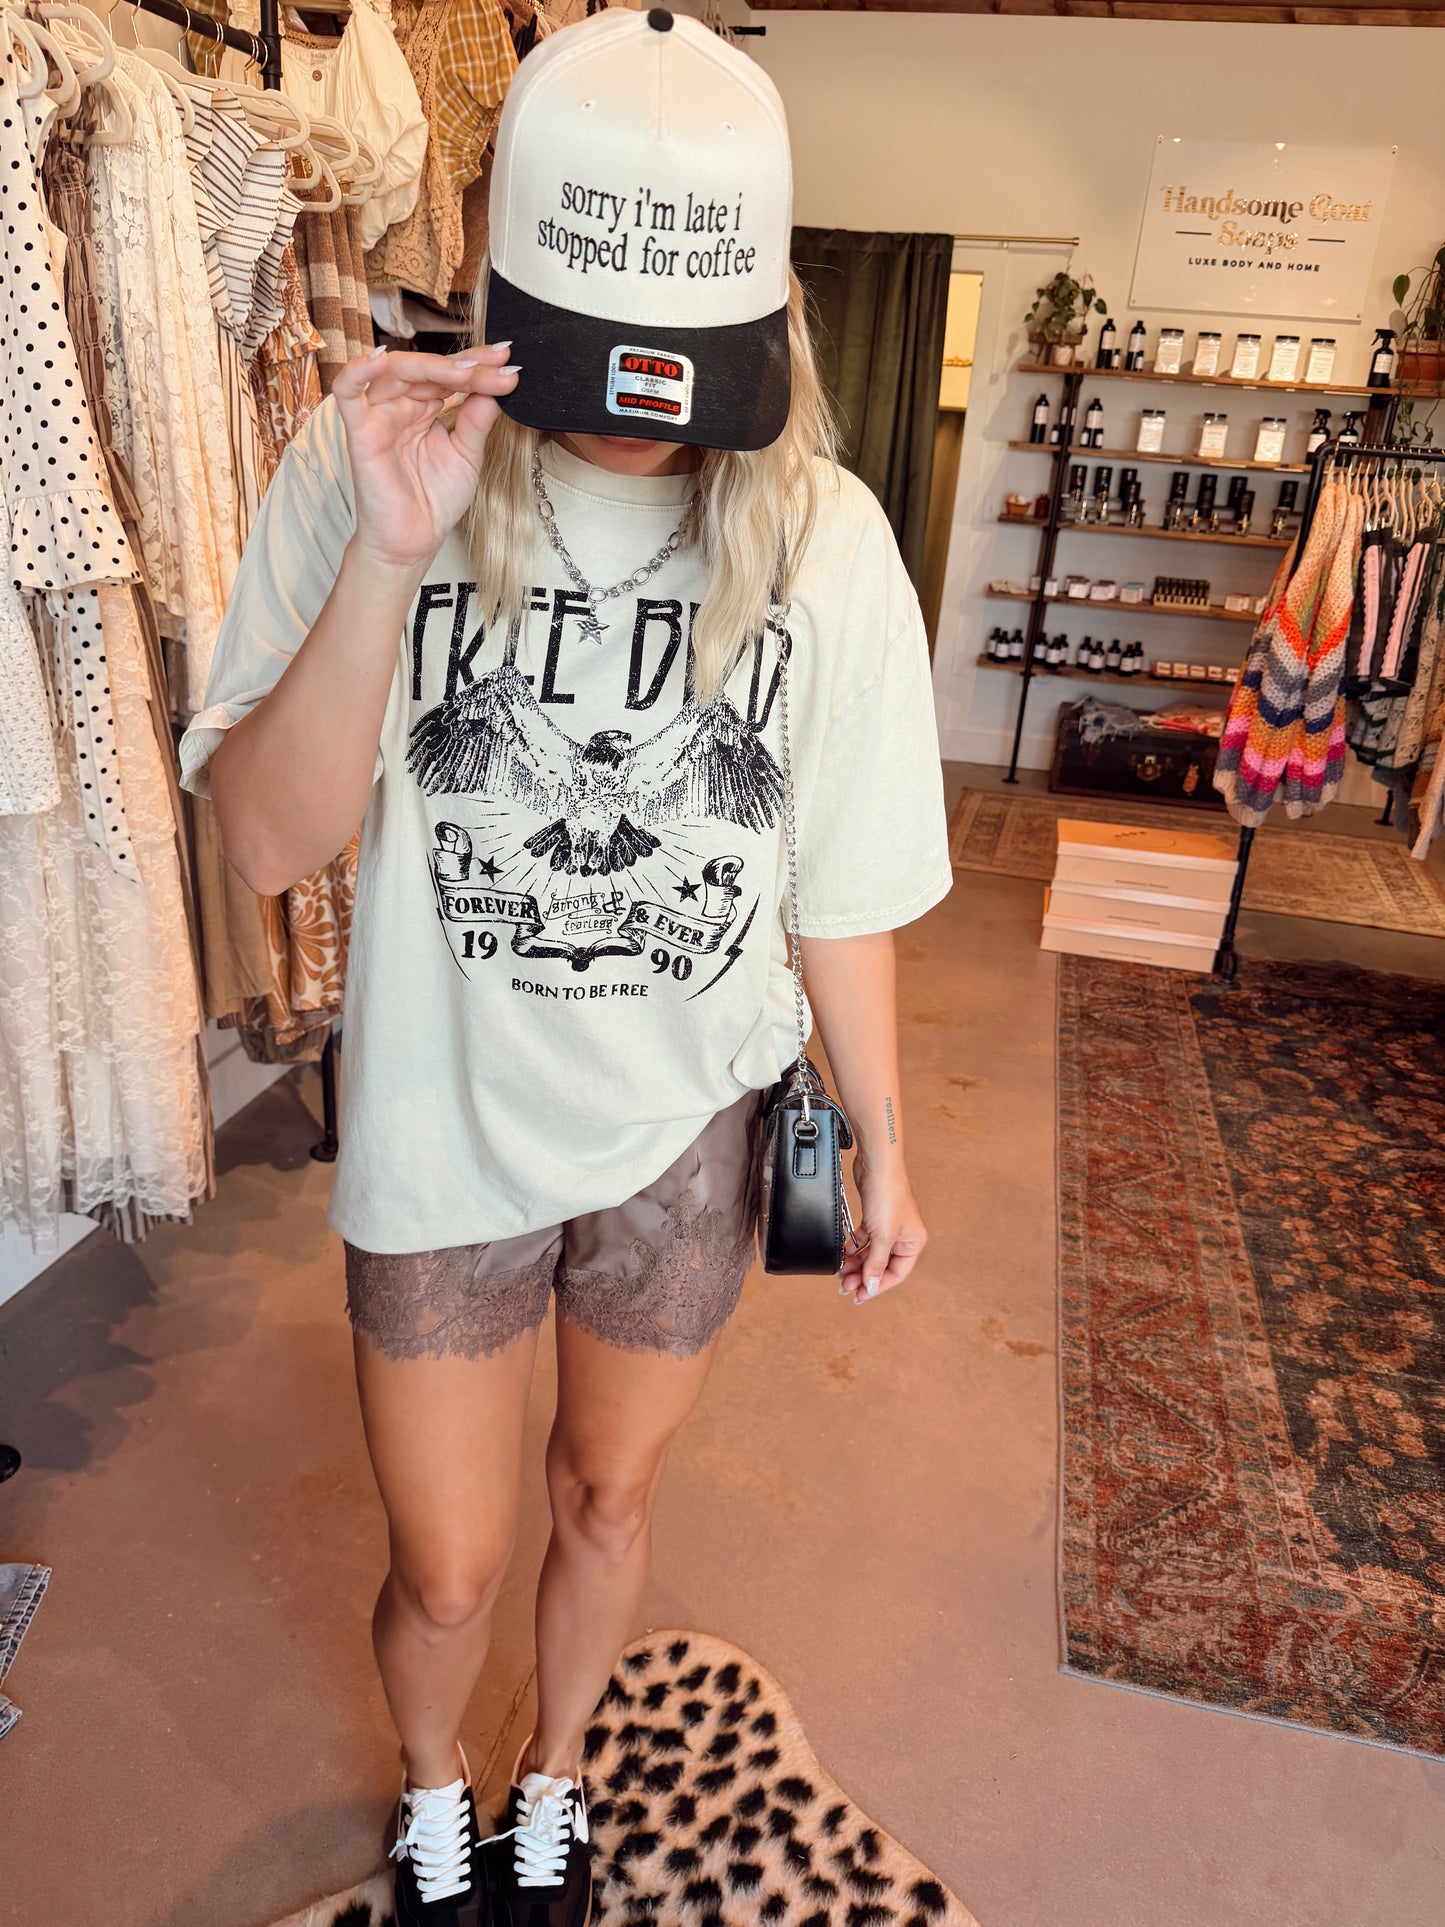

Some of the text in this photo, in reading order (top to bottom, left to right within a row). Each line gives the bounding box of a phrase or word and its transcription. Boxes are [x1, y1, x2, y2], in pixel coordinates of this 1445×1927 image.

[561, 182, 742, 233] sorry i'm late i
[1159, 184, 1374, 224] Handsome Goat
[538, 216, 755, 278] stopped for coffee
[1217, 220, 1299, 255] Soaps
[1188, 256, 1321, 272] LUXE BODY AND HOME
[625, 357, 678, 377] OTTO
[635, 375, 667, 385] CLASSIC
[619, 408, 678, 420] MAXIMUM COMFORT
[639, 399, 680, 412] PROFILE
[445, 895, 536, 919] FOREVER
[552, 895, 598, 914] strong
[564, 919, 614, 931] fearless
[635, 907, 705, 947] & EVER
[461, 930, 498, 960] 19
[651, 948, 693, 981] 90
[511, 977, 649, 1000] BORN TO BE FREE
